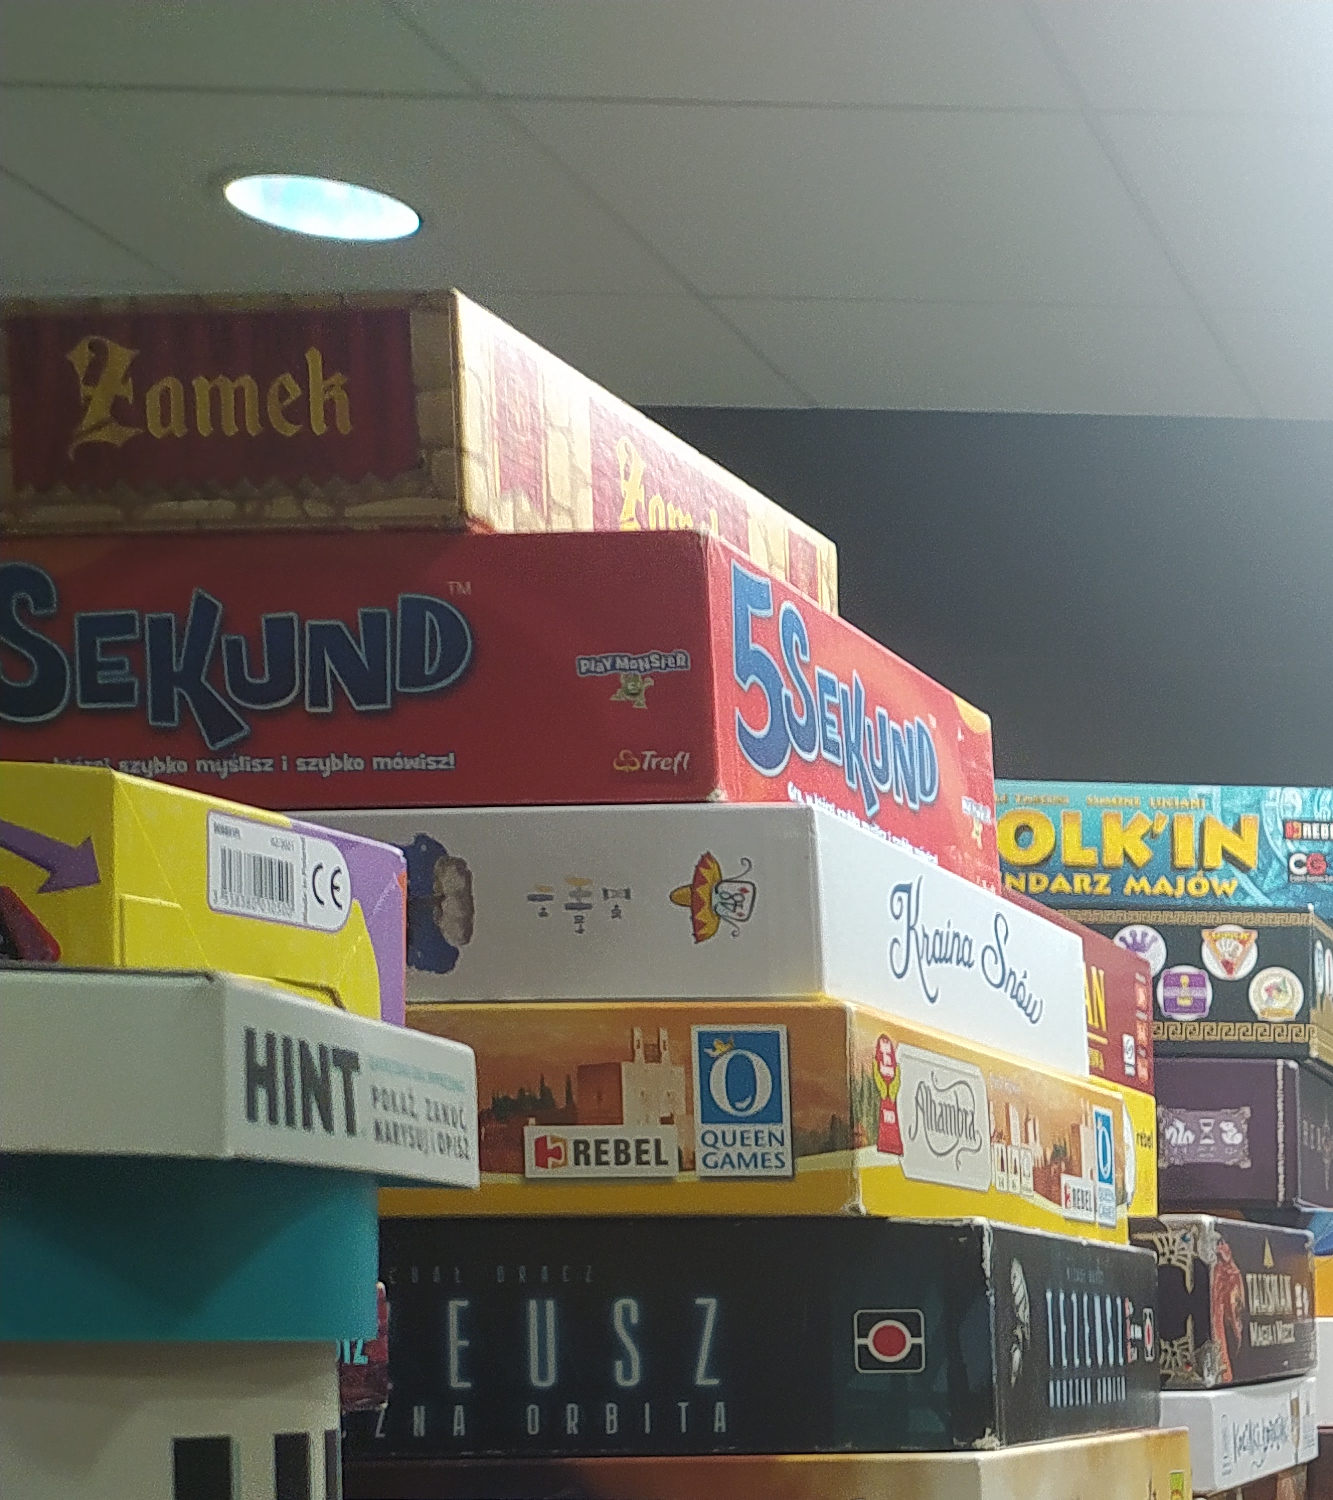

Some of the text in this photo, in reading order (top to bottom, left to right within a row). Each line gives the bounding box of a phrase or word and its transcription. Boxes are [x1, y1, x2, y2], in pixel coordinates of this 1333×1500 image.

[66, 335, 354, 460] Zamek
[730, 559, 939, 819] 5 SEKUND
[195, 753, 275, 776] myślisz
[297, 755, 366, 775] szybko
[371, 753, 456, 771] mówisz!
[640, 750, 690, 776] Trefl
[1124, 870, 1239, 898] MAJÓW
[889, 874, 976, 1004] Kraina
[981, 911, 1044, 1025] Snów
[243, 1025, 361, 1139] HINT
[907, 1078, 979, 1143] Alhambra
[572, 1138, 670, 1168] REBEL
[701, 1128, 786, 1149] QUEEN
[701, 1150, 786, 1171] GAMES
[386, 1298, 721, 1390] EUSZ
[526, 1401, 729, 1436] ORBITA
